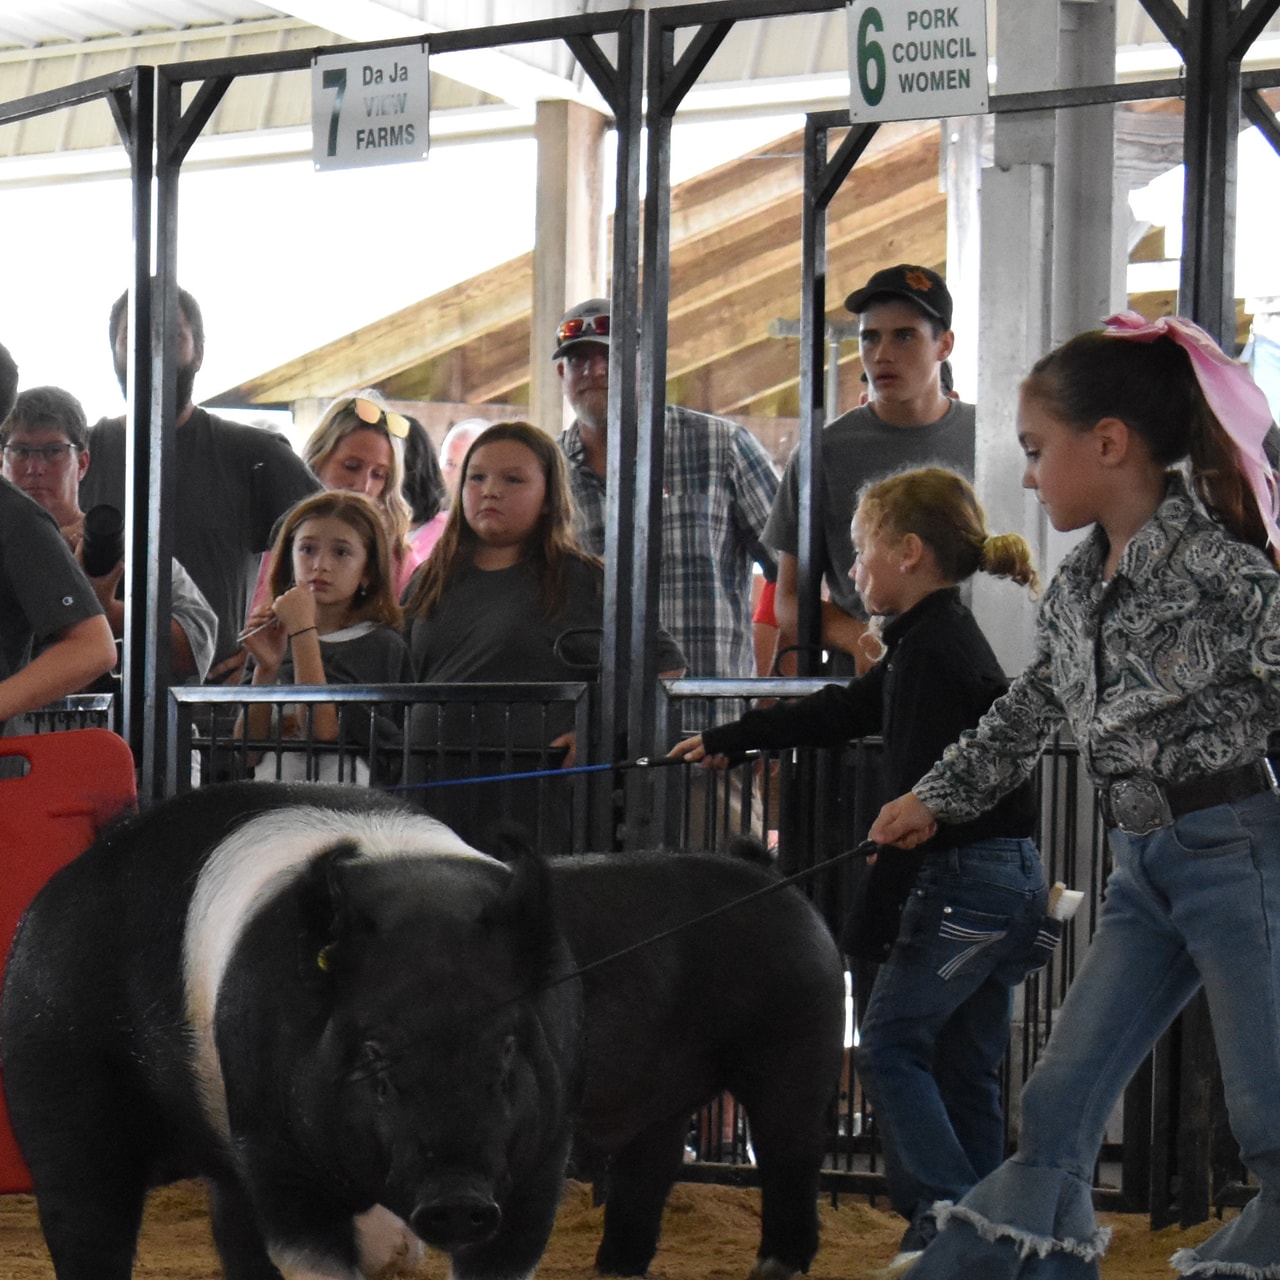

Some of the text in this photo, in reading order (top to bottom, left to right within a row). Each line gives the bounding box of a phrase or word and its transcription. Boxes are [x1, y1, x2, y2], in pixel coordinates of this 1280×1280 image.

[907, 7, 959, 31] PORK
[857, 6, 886, 107] 6
[892, 37, 977, 63] COUNCIL
[362, 62, 408, 86] Da Ja
[898, 68, 971, 94] WOMEN
[322, 67, 347, 157] 7
[356, 123, 415, 150] FARMS
